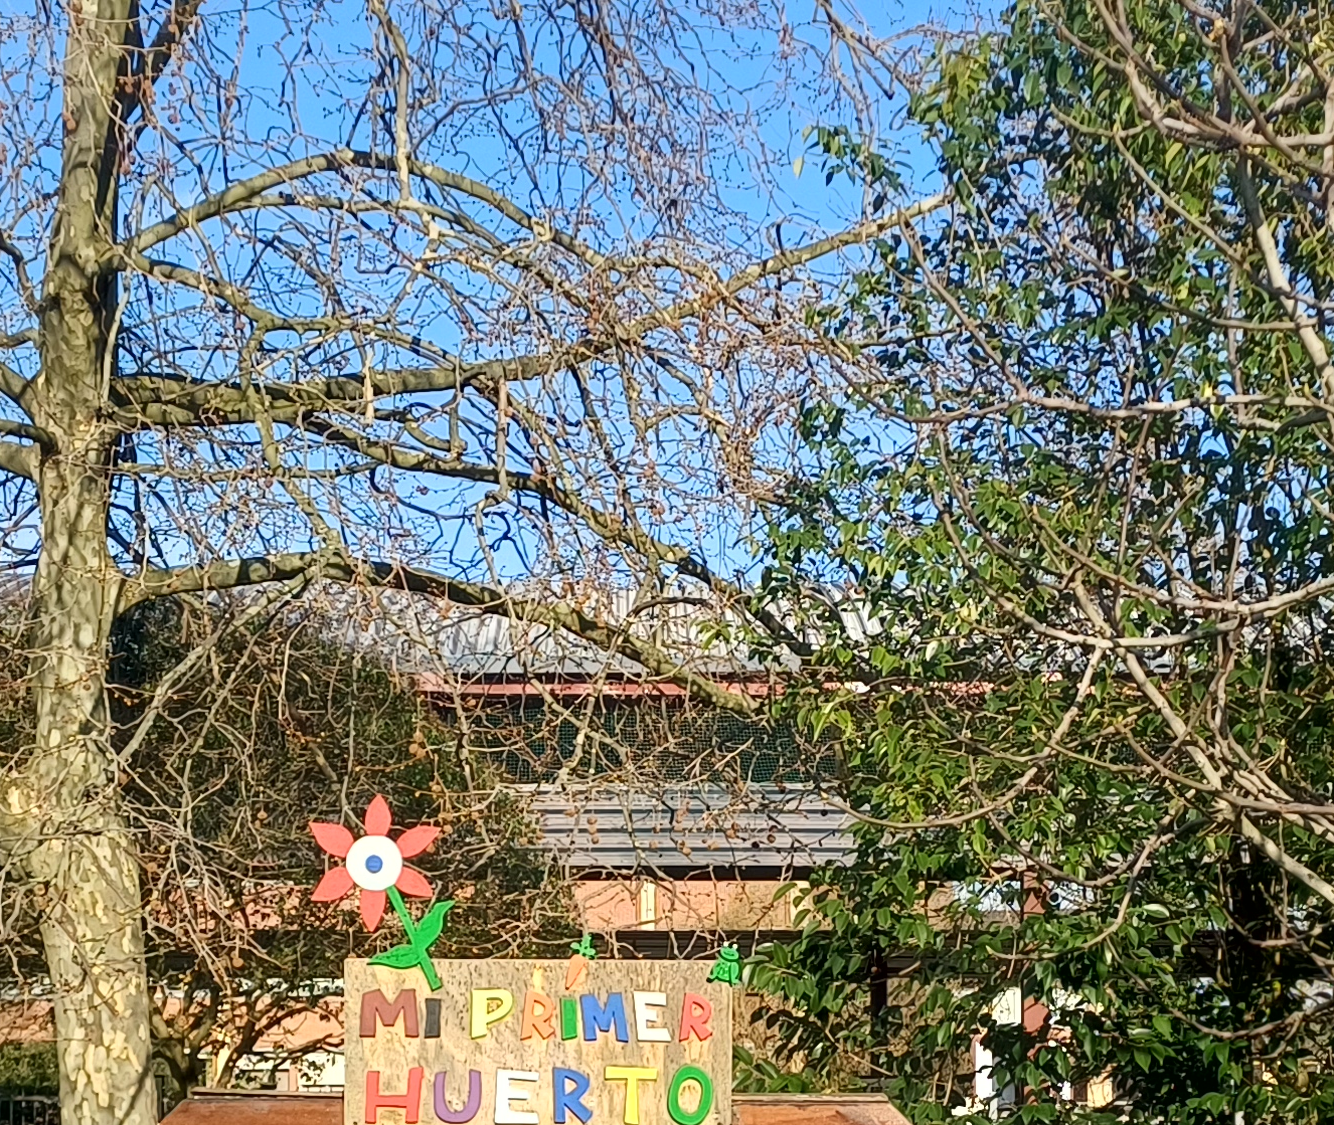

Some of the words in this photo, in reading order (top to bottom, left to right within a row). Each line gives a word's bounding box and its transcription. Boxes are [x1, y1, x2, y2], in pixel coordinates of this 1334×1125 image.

[359, 989, 442, 1039] MI
[471, 989, 713, 1042] PRIMER
[365, 1064, 714, 1125] HUERTO
